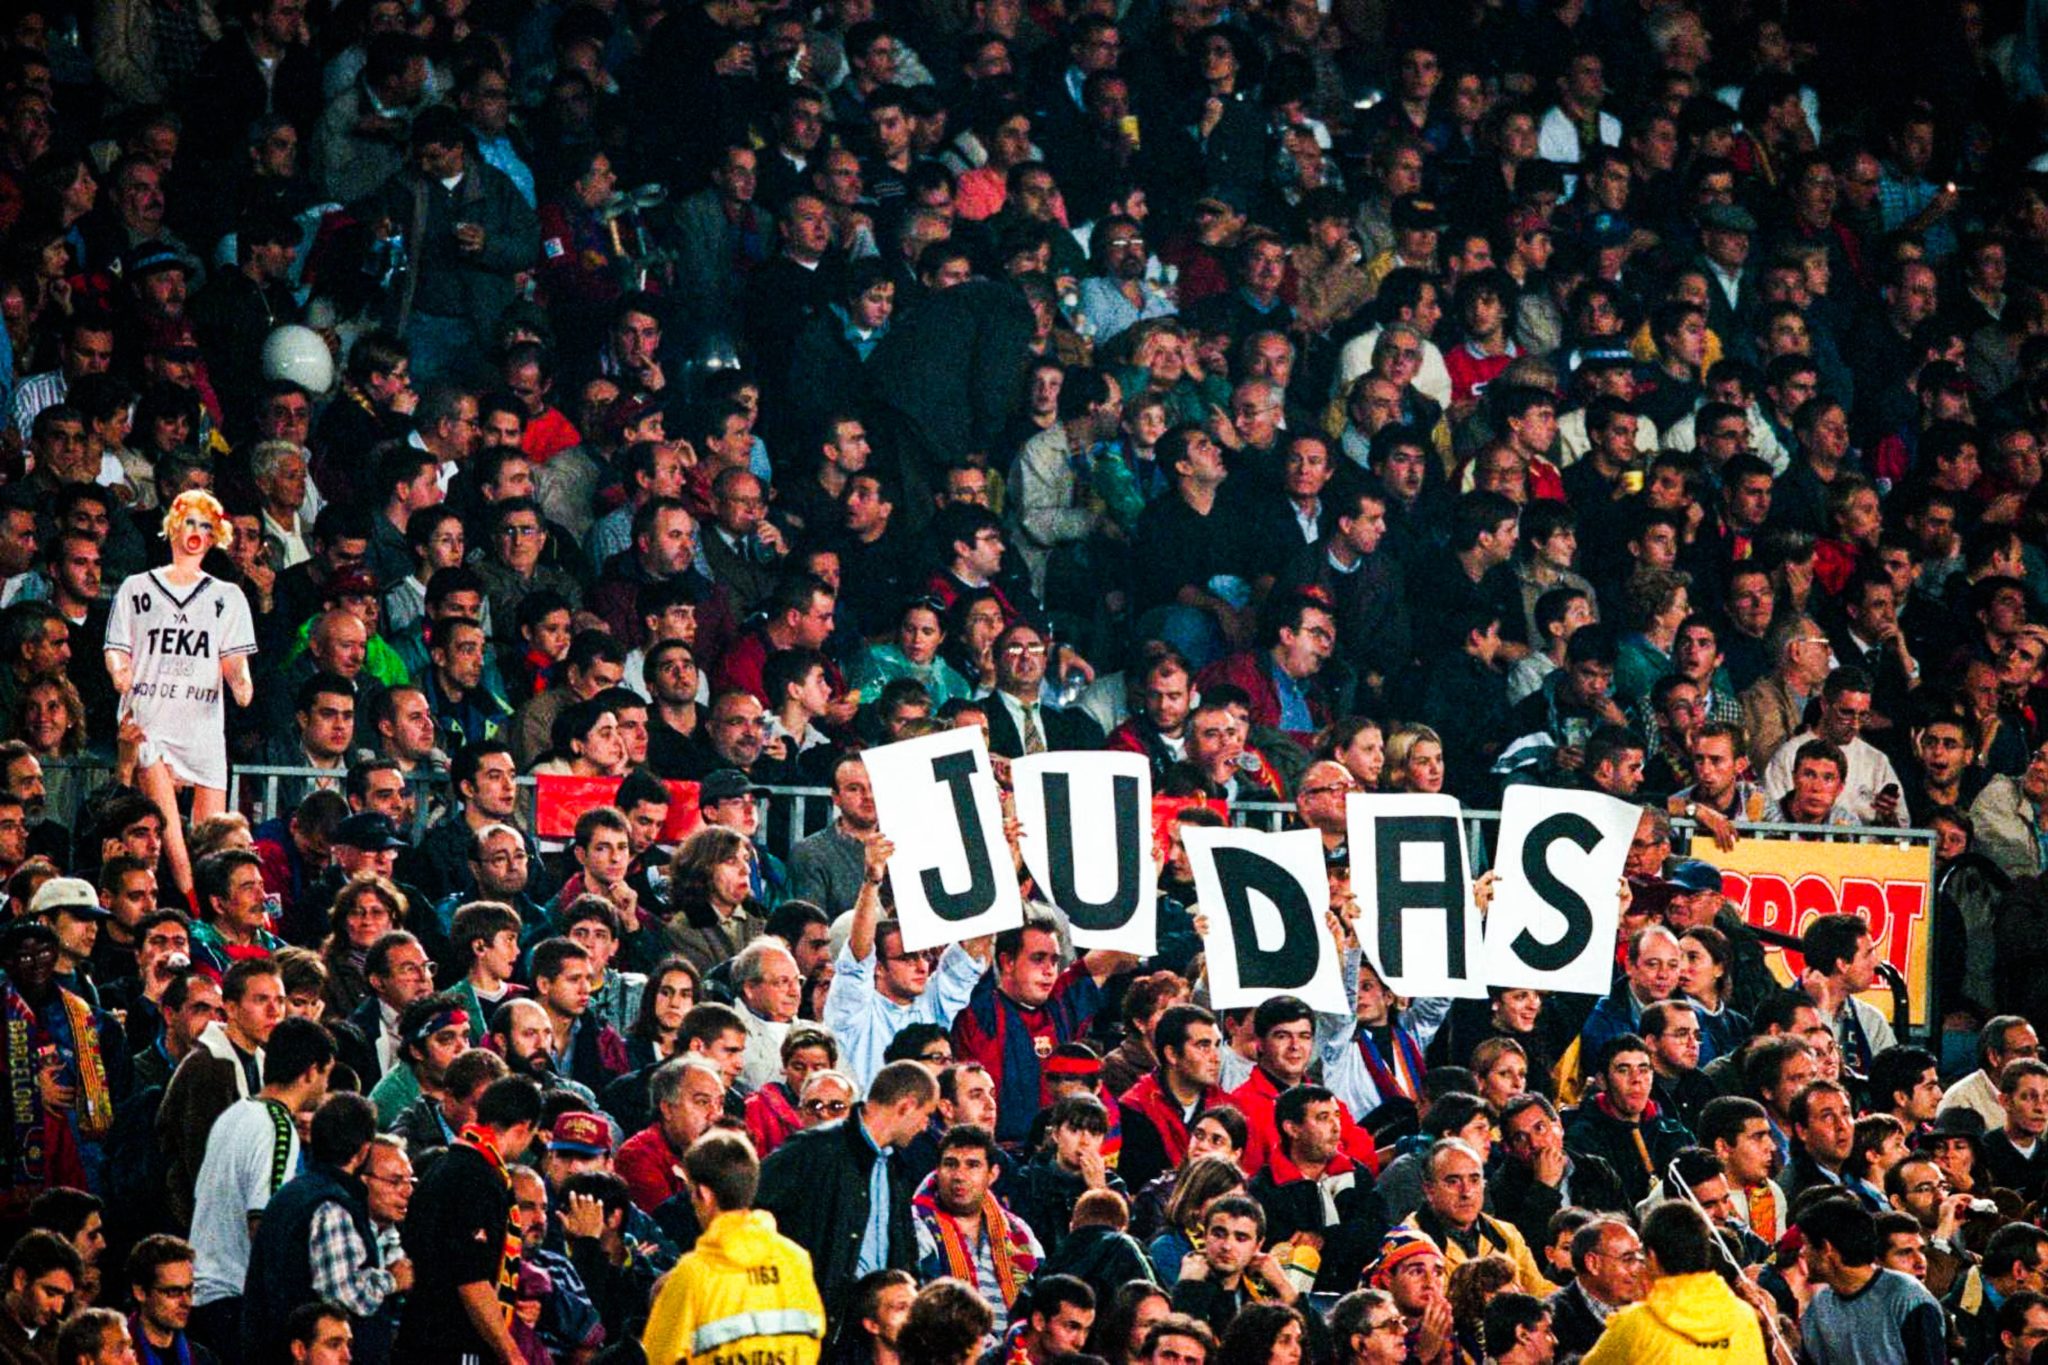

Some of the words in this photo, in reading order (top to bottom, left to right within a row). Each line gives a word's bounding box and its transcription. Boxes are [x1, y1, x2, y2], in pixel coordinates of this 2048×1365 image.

[132, 593, 151, 614] 10
[173, 613, 188, 623] YA
[148, 628, 210, 658] TEKA
[160, 684, 178, 698] DE
[8, 1019, 34, 1123] BARCELONA
